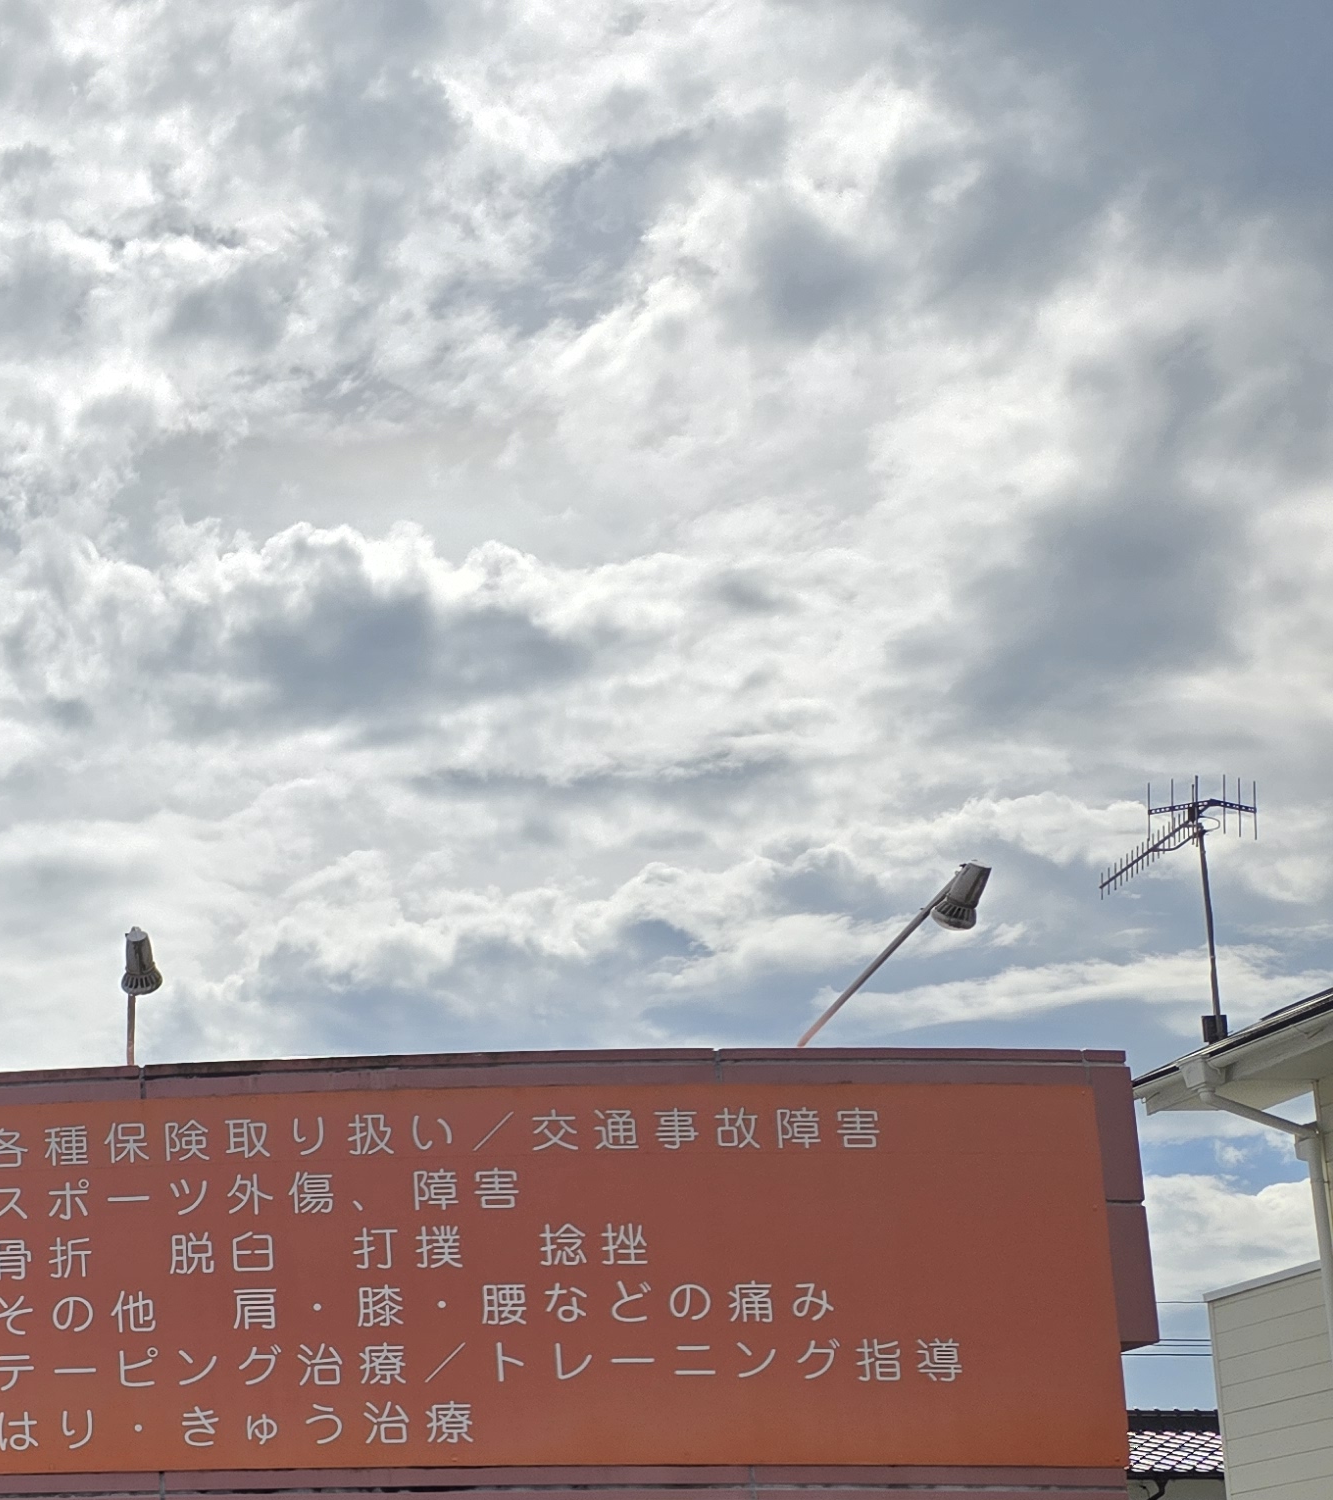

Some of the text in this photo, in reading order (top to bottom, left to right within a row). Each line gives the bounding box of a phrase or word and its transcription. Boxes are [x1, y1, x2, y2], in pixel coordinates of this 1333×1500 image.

[169, 1232, 275, 1275] 脱臼
[354, 1226, 463, 1270] 打撲
[540, 1222, 647, 1266] 捻挫
